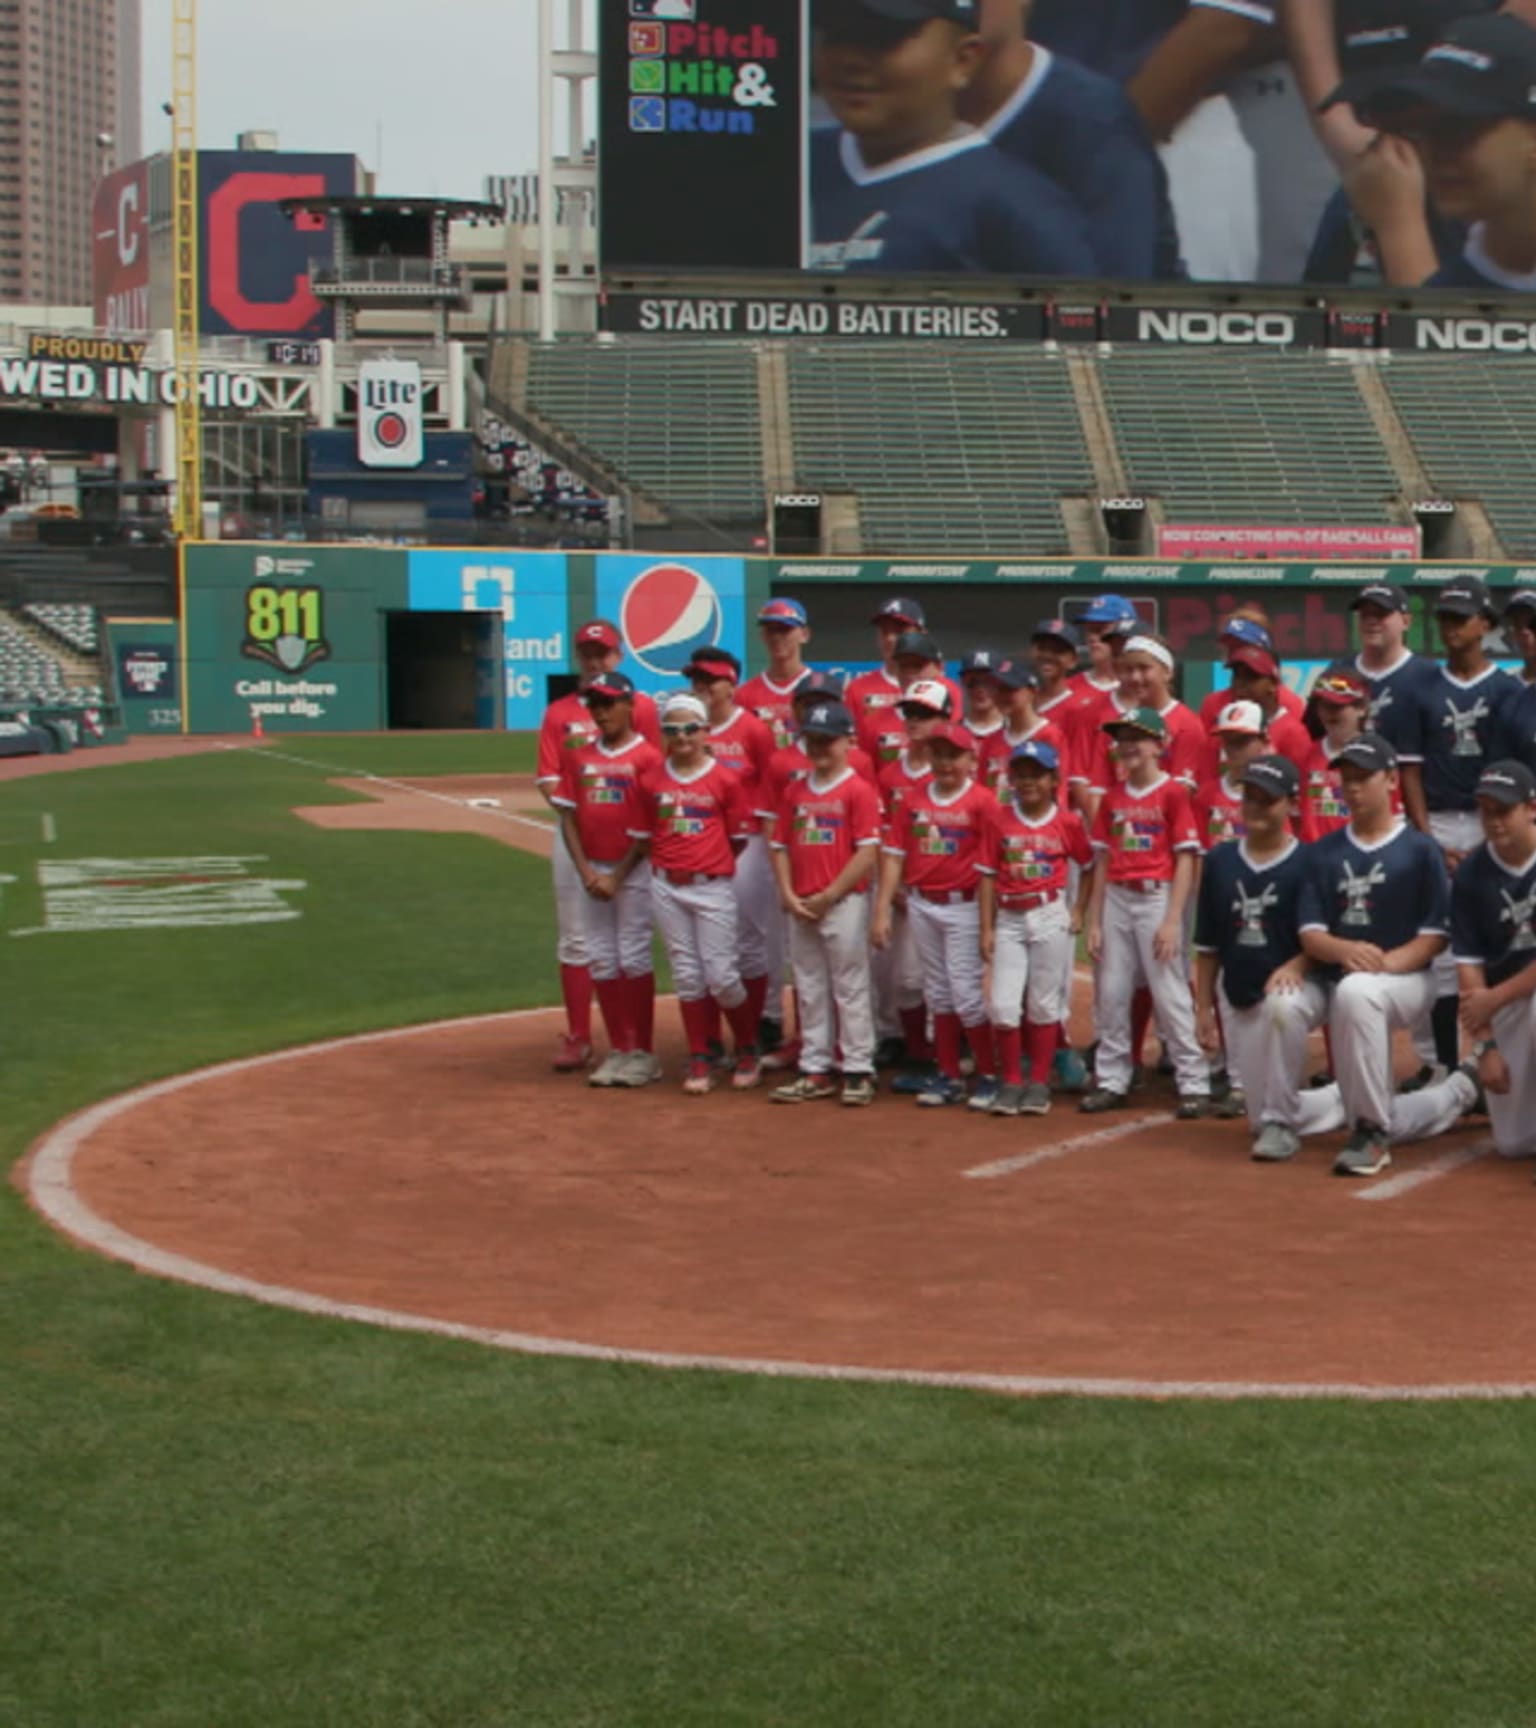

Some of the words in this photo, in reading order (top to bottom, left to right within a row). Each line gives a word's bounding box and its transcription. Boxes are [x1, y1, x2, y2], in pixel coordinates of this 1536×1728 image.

[669, 22, 777, 59] Pitch
[669, 59, 734, 96] Hit
[733, 62, 777, 106] &
[669, 98, 754, 134] Run
[639, 299, 737, 330] START
[746, 303, 828, 333] DEAD
[838, 305, 1008, 336] BATTERIES.
[1138, 310, 1294, 344] NOCO
[31, 336, 145, 363] PROUDLY
[106, 366, 149, 402] IN
[364, 378, 417, 410] Lite
[248, 586, 320, 641] 811
[236, 680, 273, 697] Call
[275, 680, 338, 697] before
[250, 701, 286, 719] you
